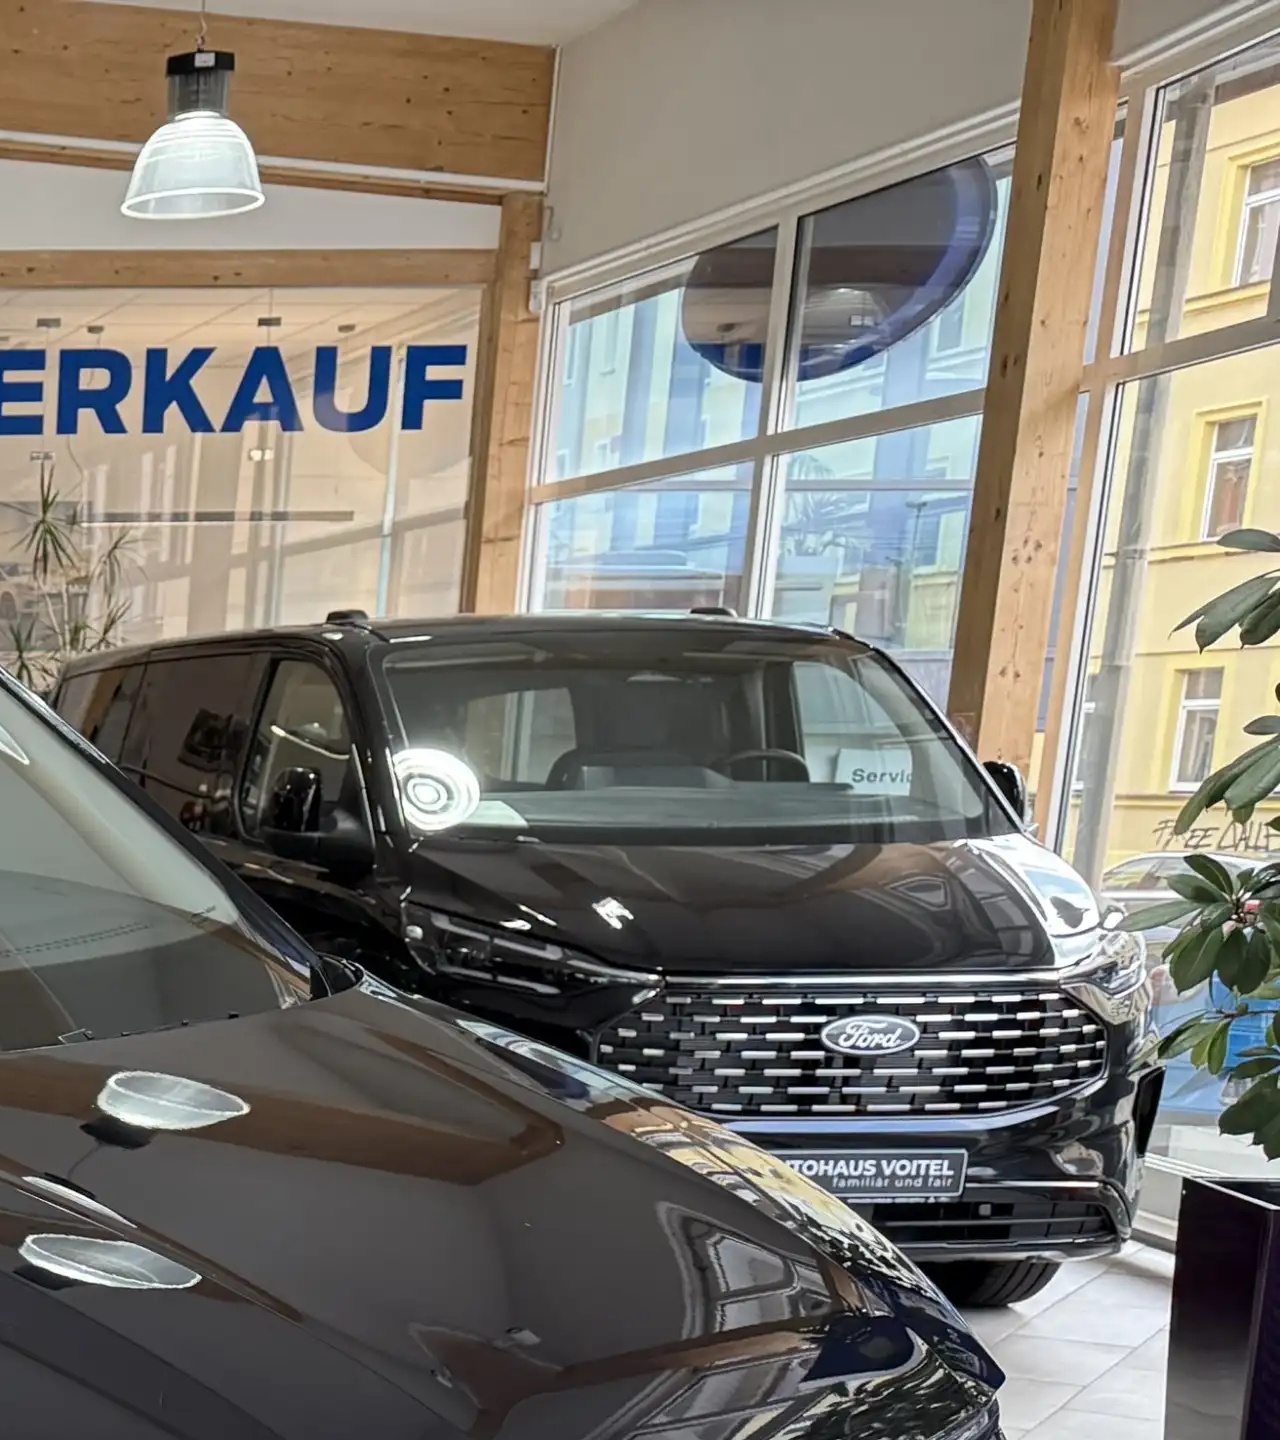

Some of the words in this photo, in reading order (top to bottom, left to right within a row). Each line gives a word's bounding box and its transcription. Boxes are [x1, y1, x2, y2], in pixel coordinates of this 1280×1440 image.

[837, 1019, 905, 1049] Ford
[881, 1159, 954, 1177] VOITEL
[894, 1176, 924, 1188] und
[927, 1176, 954, 1188] fair
